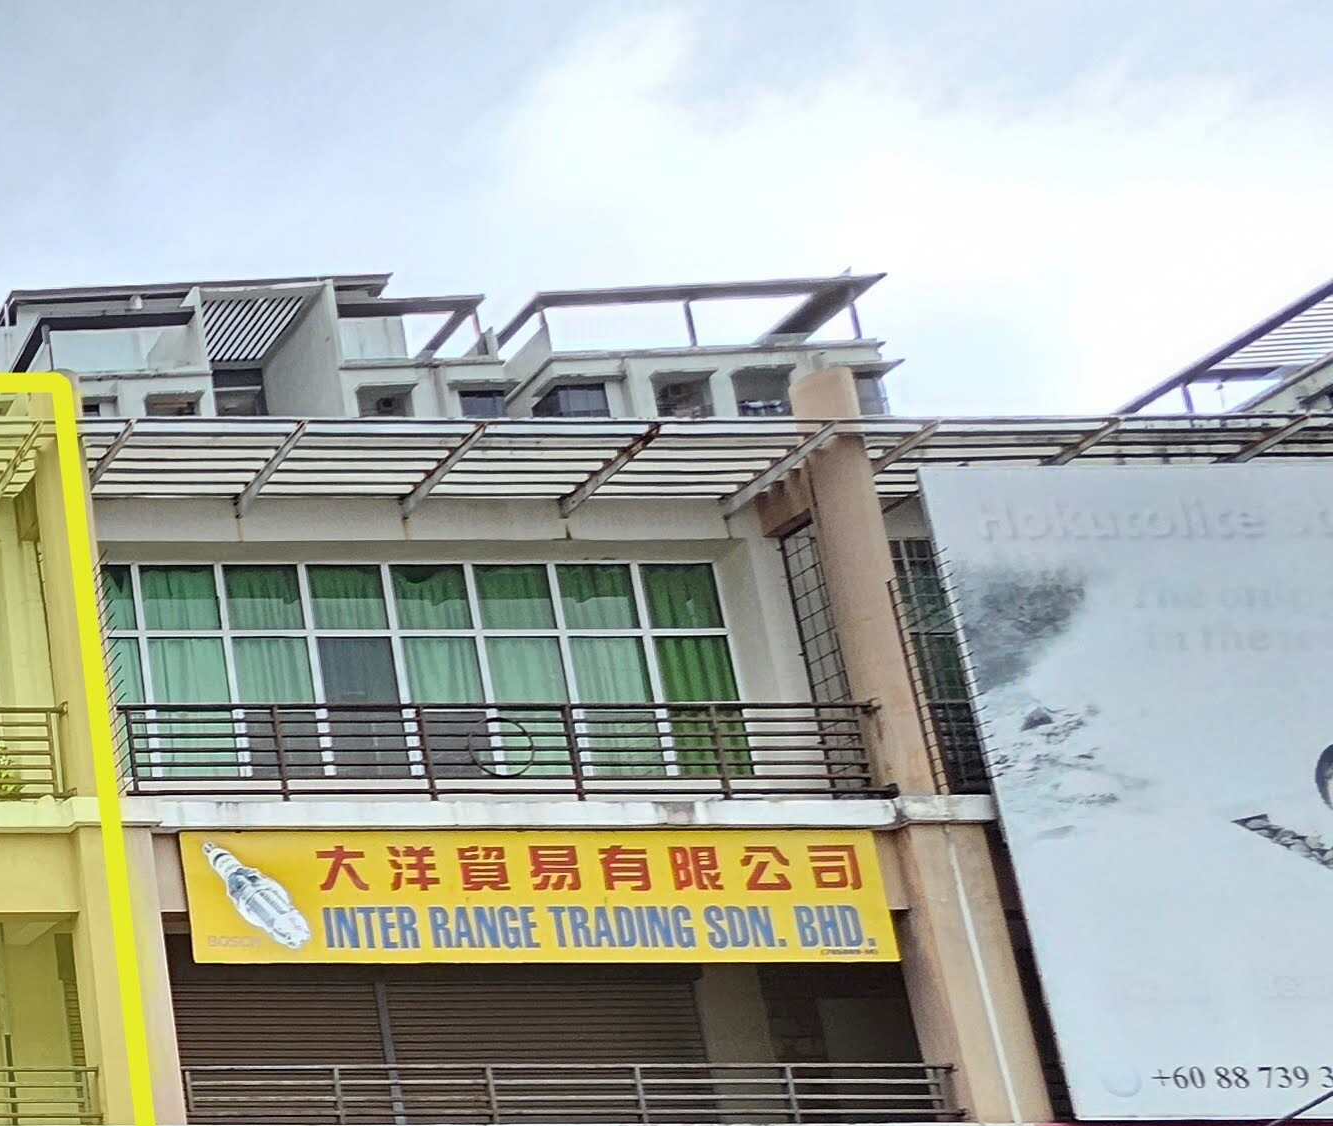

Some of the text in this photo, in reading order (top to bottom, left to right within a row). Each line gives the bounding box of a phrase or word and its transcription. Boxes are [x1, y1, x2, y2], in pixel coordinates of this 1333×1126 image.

[315, 845, 865, 892] 大洋貿易有限公司
[323, 904, 877, 949] INTER RANGE TRADING SDN. BHD.
[1214, 1066, 1251, 1089] 88
[1257, 1066, 1310, 1089] 739
